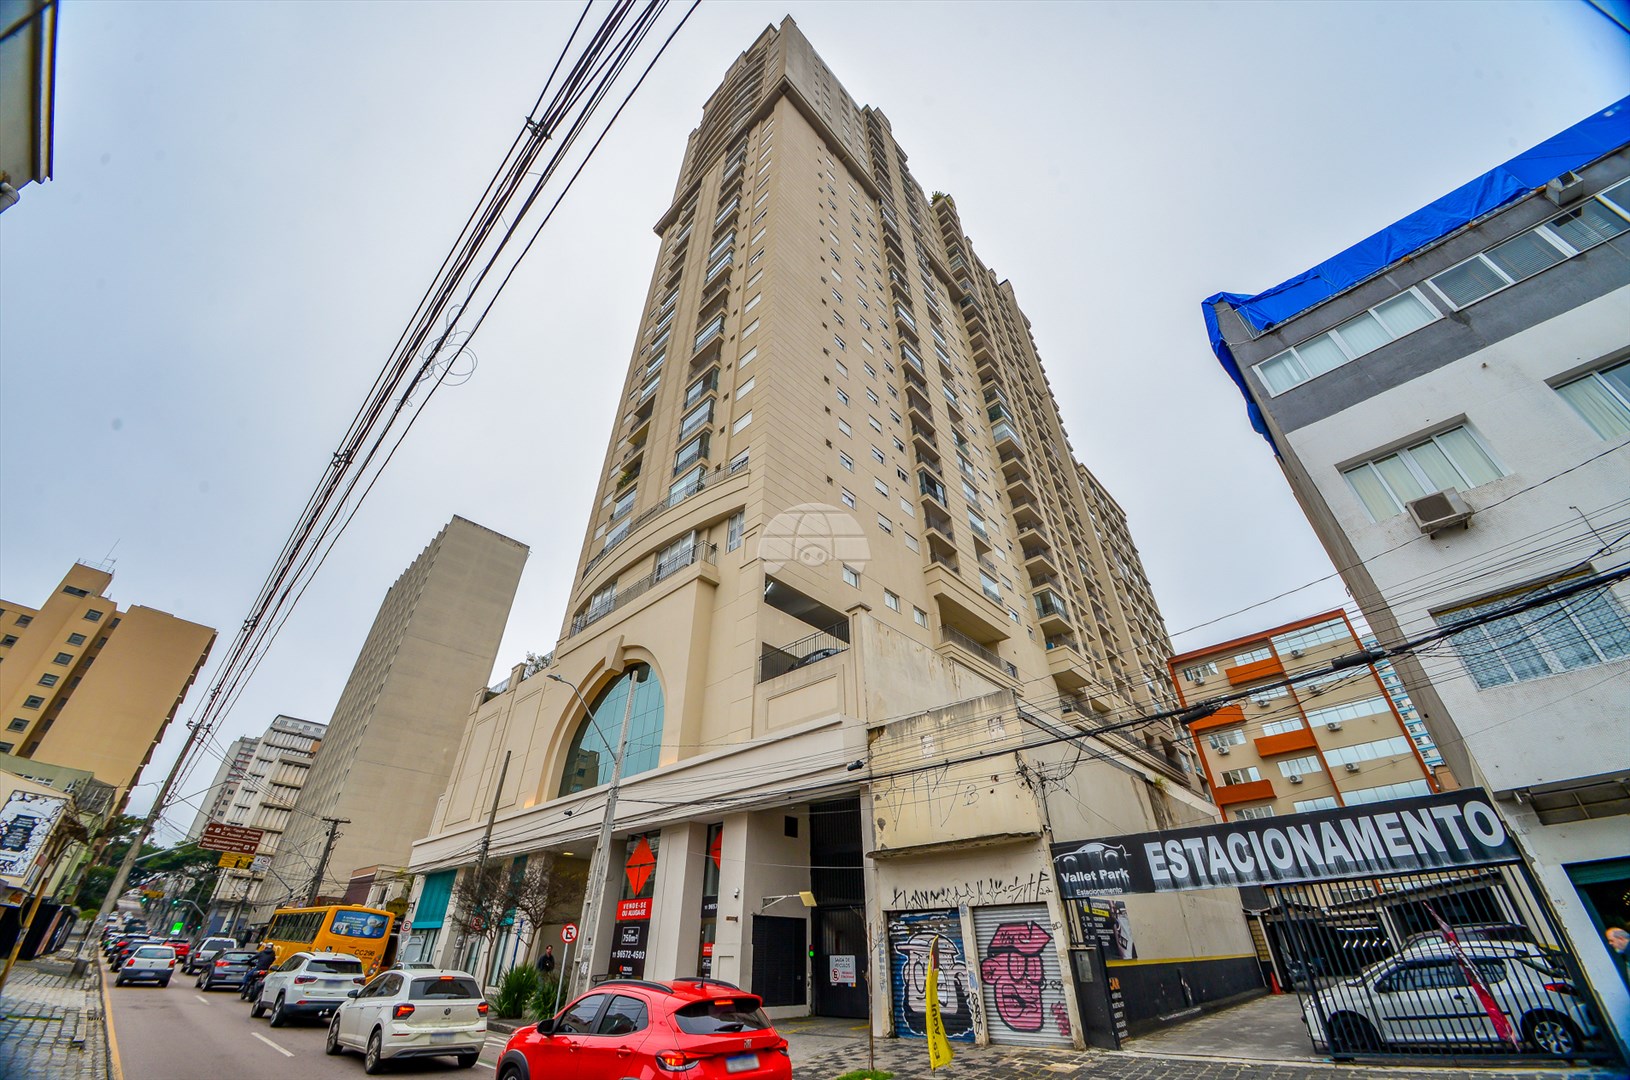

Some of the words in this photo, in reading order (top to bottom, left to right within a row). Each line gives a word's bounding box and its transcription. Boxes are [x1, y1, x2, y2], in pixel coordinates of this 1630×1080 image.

[1144, 800, 1505, 881] ESTACIONAMENTO
[1061, 870, 1097, 883] Vallet
[1099, 868, 1130, 880] Park
[1076, 887, 1123, 896] Estacionamento
[623, 901, 647, 909] VENDE-SE
[931, 1003, 941, 1035] AQUI
